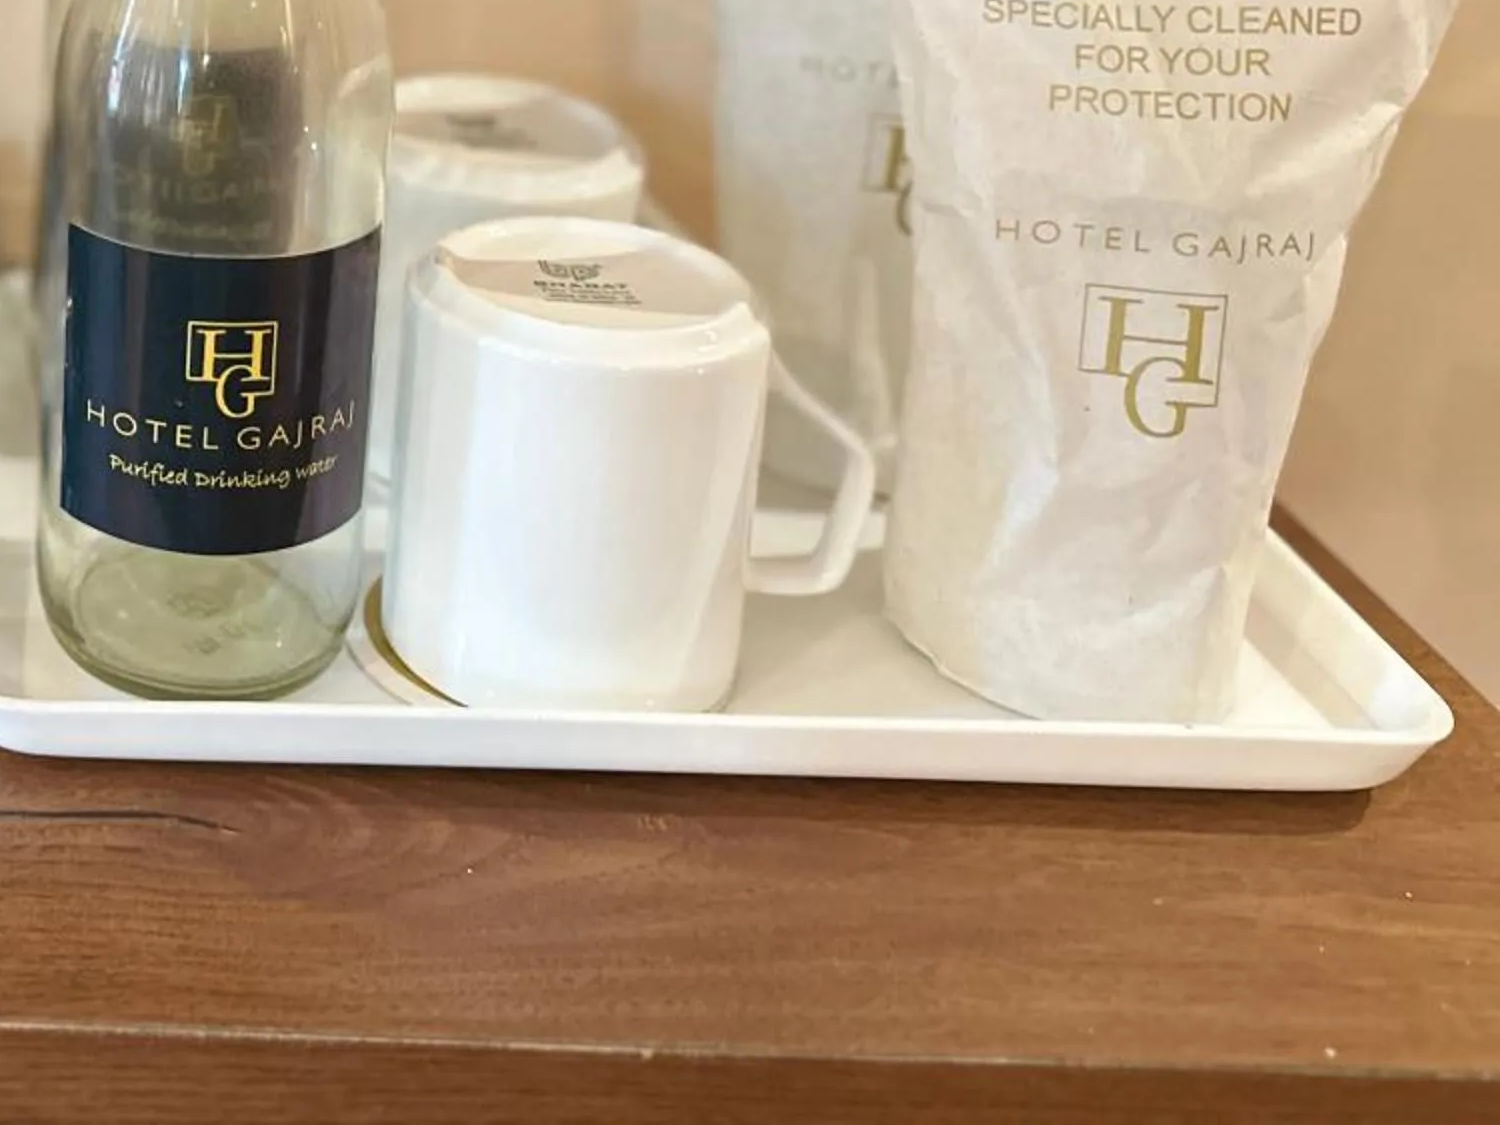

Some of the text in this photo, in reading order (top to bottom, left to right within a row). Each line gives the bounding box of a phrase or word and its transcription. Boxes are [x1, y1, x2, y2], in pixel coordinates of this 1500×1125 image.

[1186, 6, 1362, 37] CLEANED
[1074, 44, 1271, 77] FOR YOUR
[1048, 85, 1292, 122] PROTECTION
[994, 219, 1316, 265] HOTEL GAJRAJ
[86, 399, 356, 451] HOTEL GAJRAJ
[109, 454, 189, 487] Purified
[194, 467, 292, 490] Drinking
